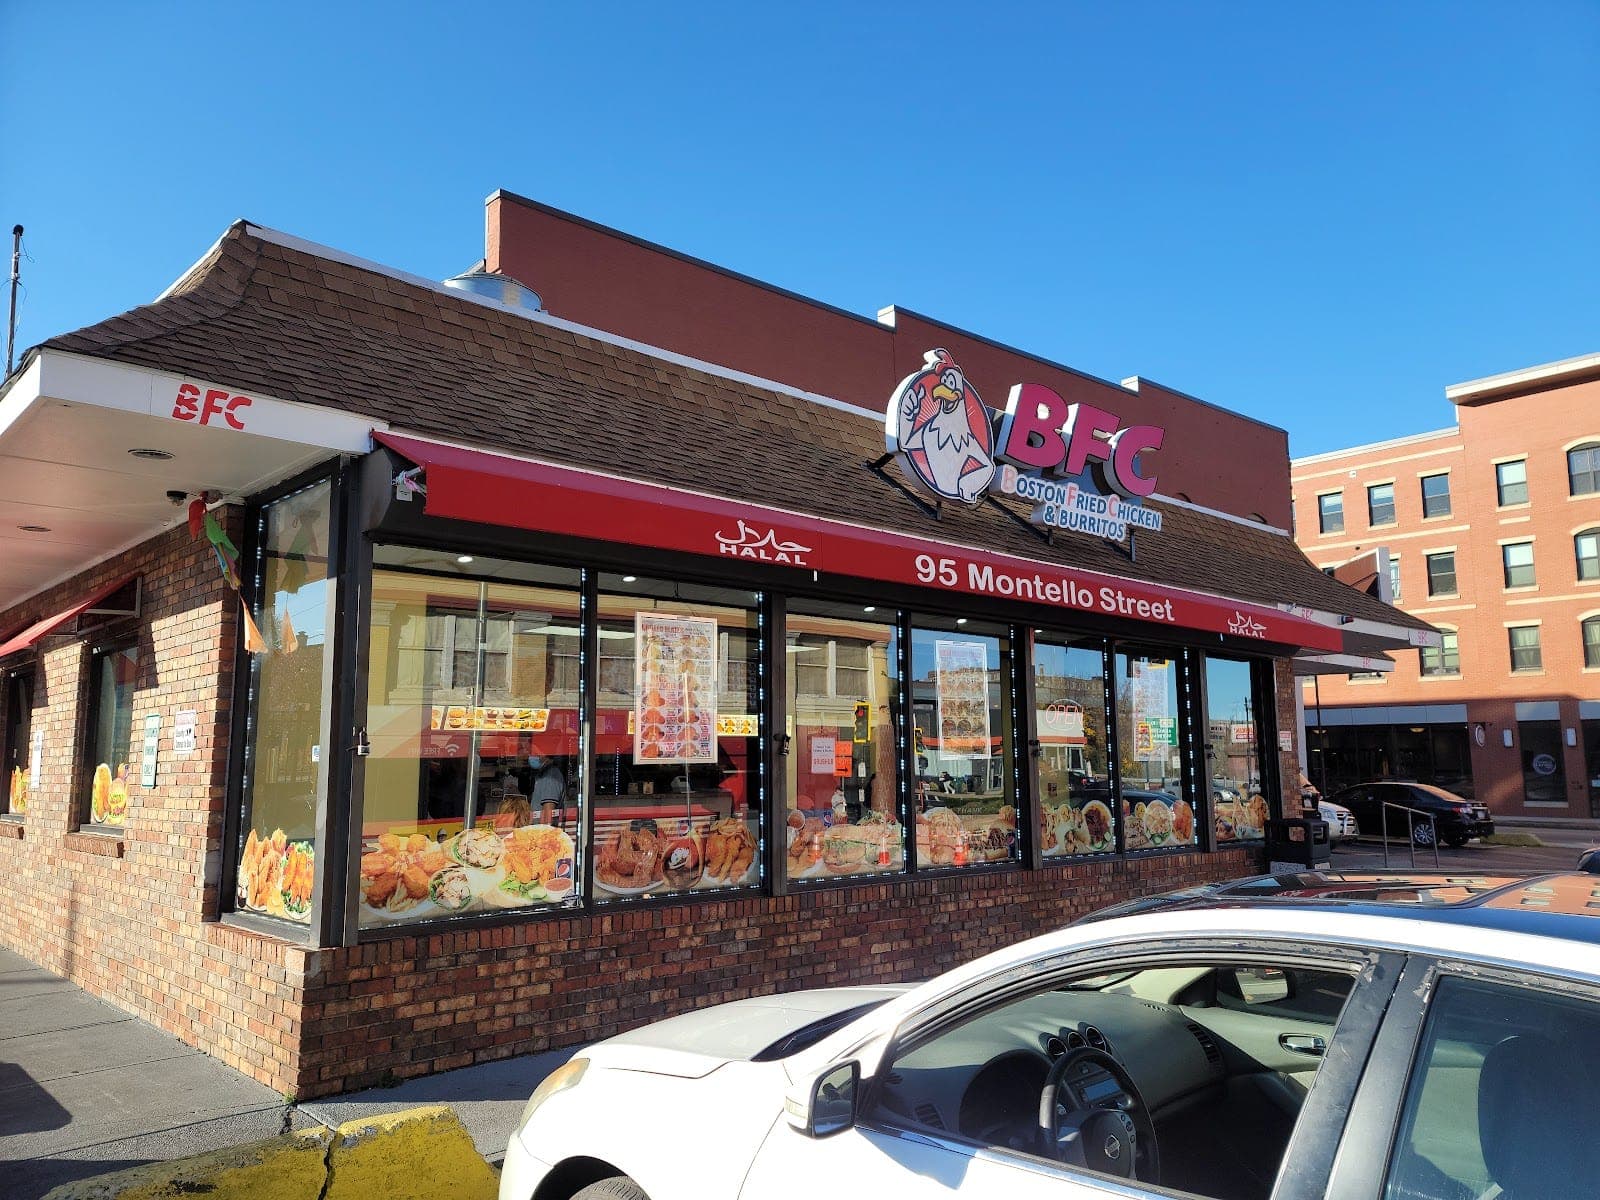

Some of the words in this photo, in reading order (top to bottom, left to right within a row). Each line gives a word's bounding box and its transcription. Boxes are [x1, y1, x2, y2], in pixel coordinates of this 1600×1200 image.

[172, 383, 252, 430] BFC
[1005, 383, 1165, 497] BFC
[1003, 465, 1065, 503] BOSTON
[1065, 482, 1107, 516] FRIED
[1107, 494, 1161, 530] CHICKEN
[1044, 506, 1056, 523] &
[1058, 509, 1126, 541] BURRITOS
[719, 542, 807, 566] HALAL
[914, 555, 959, 587] 95
[967, 564, 1094, 608] Montello
[1099, 587, 1176, 622] Street
[1229, 625, 1265, 639] HALAL
[1045, 704, 1084, 725] OPEN
